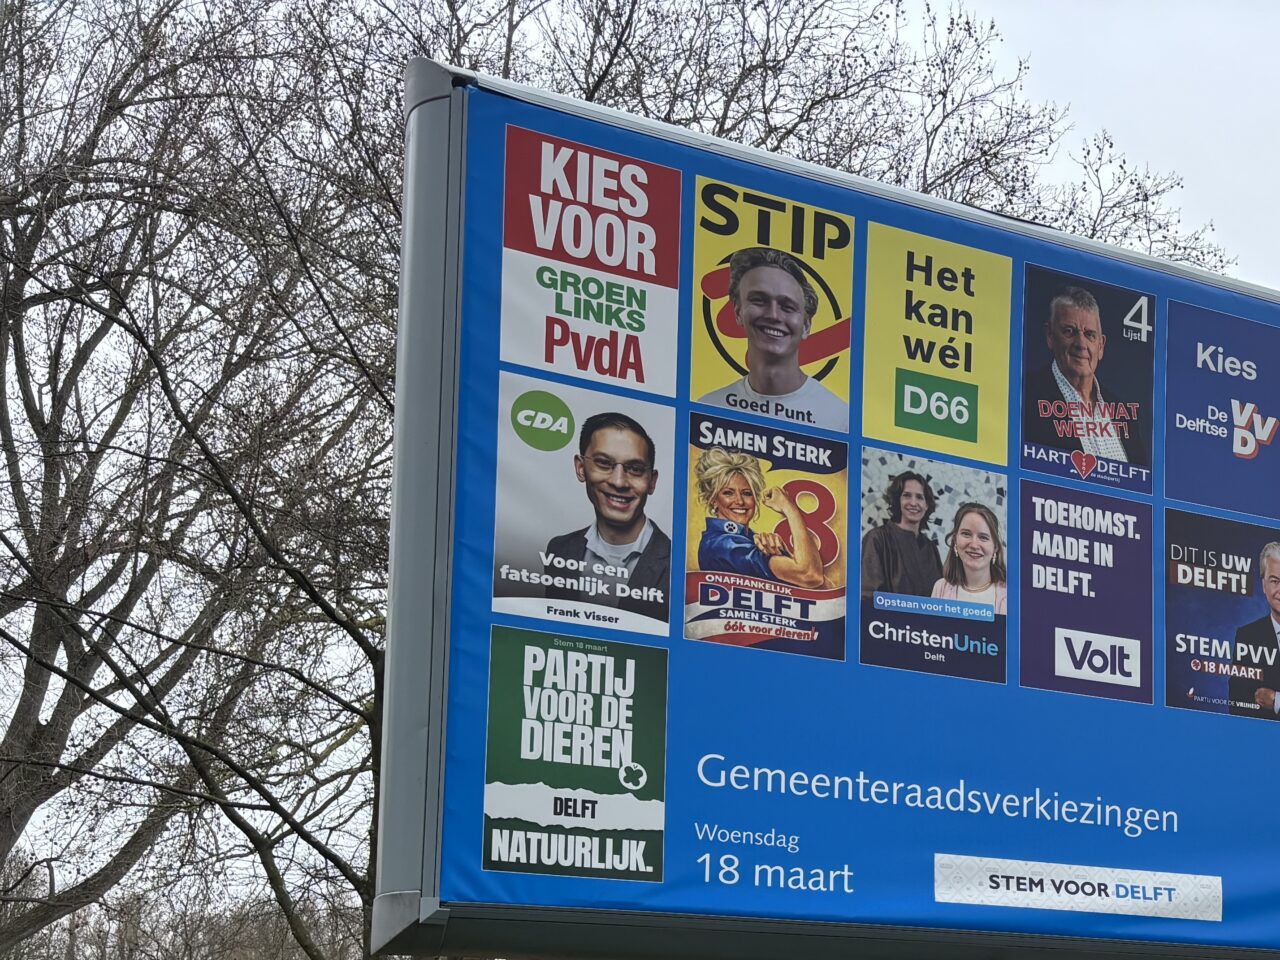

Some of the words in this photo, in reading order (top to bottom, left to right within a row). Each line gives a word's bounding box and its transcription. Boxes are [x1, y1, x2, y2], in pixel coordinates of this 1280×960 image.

[540, 141, 648, 218] KIES
[528, 194, 656, 276] VOOR
[699, 183, 851, 260] STIP
[535, 265, 647, 311] GROEN
[905, 250, 976, 298] Het
[554, 291, 646, 333] LINKS
[904, 289, 973, 335] kan
[1123, 295, 1152, 343] 4
[544, 315, 645, 384] PvdA
[902, 334, 972, 373] wél
[1123, 328, 1141, 342] Lijst
[1196, 342, 1257, 381] Kies
[516, 409, 569, 434] CDA
[725, 393, 770, 417] Goed
[774, 403, 816, 424] Punt.
[903, 384, 970, 425] D66
[1038, 399, 1093, 419] DOEN
[1097, 401, 1140, 421] WAT
[1207, 405, 1228, 423] De
[699, 421, 767, 454] SAMEN
[772, 436, 832, 467] STERK
[1053, 419, 1129, 439] WERKT!
[1175, 413, 1228, 438] Delftse
[1023, 444, 1071, 465] HART
[1097, 460, 1150, 481] DELFT
[774, 479, 839, 568] 8
[1031, 496, 1141, 540] TOEKOMST.
[539, 551, 587, 573] Voor
[592, 561, 629, 579] een
[1031, 530, 1090, 566] MADE
[1093, 543, 1113, 568] IN
[1170, 543, 1198, 564] DIT
[1203, 550, 1217, 567] IS
[1221, 552, 1252, 573] UW
[500, 565, 610, 596] fatsoenlijk
[615, 585, 664, 604] Delft
[705, 574, 793, 595] ONAFHANKELIJK
[1032, 563, 1096, 598] DELFT.
[1176, 565, 1247, 594] DELFT!
[546, 605, 580, 620] Frank
[583, 609, 620, 625] Visser
[699, 582, 817, 620] DELFT
[719, 609, 759, 621] SAMEN
[762, 614, 797, 628] STERK
[876, 596, 919, 611] Opstaan
[920, 601, 943, 612] voor
[945, 602, 961, 614] het
[962, 606, 993, 618] goede
[585, 644, 608, 652] maart
[748, 625, 772, 635] voor
[774, 627, 817, 641] dieren!
[868, 620, 999, 656] ChristenUnie
[1175, 633, 1231, 660] STEM
[1236, 642, 1278, 666] PVV
[523, 645, 636, 699] PARTIJ
[924, 651, 946, 663] Delft
[1063, 636, 1132, 678] Volt
[1203, 661, 1216, 673] 18
[1218, 663, 1262, 680] MAART
[522, 685, 594, 726] VOOR
[600, 694, 633, 730] DE
[520, 718, 633, 769] DIEREN
[552, 796, 598, 820] DELFT
[697, 753, 1178, 838] Gemeenteraadsverkiezingen
[491, 828, 654, 873] NATUURLIJK.
[694, 822, 800, 853] Woensdag
[696, 853, 740, 885] 18
[754, 862, 854, 893] maart
[988, 874, 1045, 893] STEM
[1050, 879, 1110, 898] VOOR
[1115, 883, 1176, 903] DELFT
